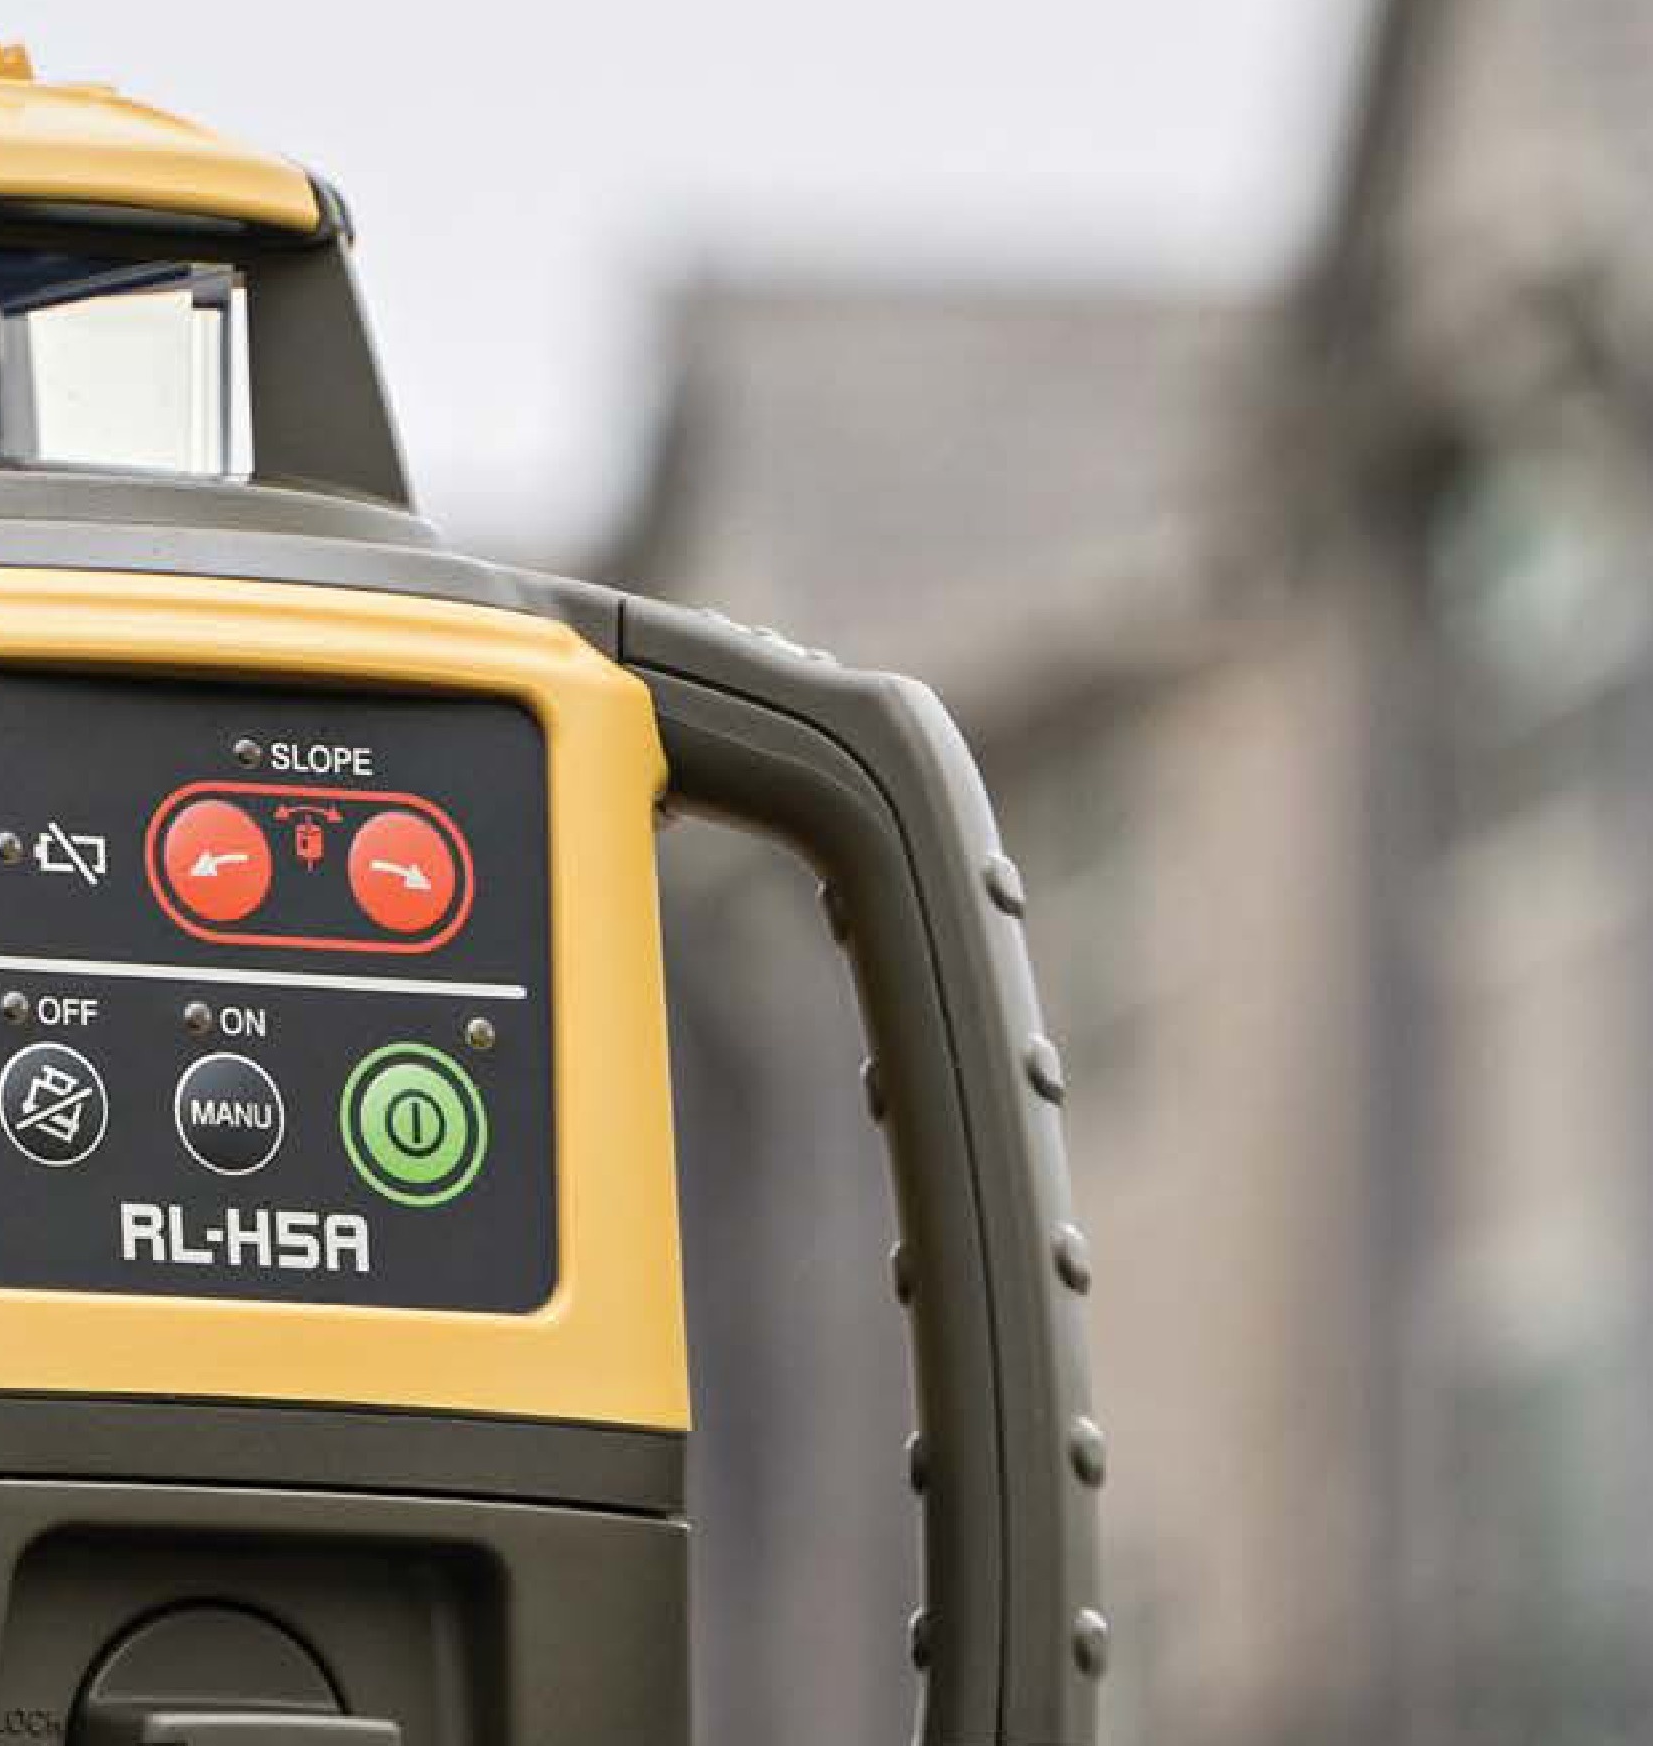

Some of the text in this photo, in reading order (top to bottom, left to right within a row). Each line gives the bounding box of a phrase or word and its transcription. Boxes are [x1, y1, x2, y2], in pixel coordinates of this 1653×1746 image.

[270, 742, 373, 777] SLOPE
[38, 998, 98, 1027] OFF
[220, 1008, 266, 1038] ON
[191, 1099, 272, 1130] MANU
[120, 1203, 370, 1272] RL-H5A
